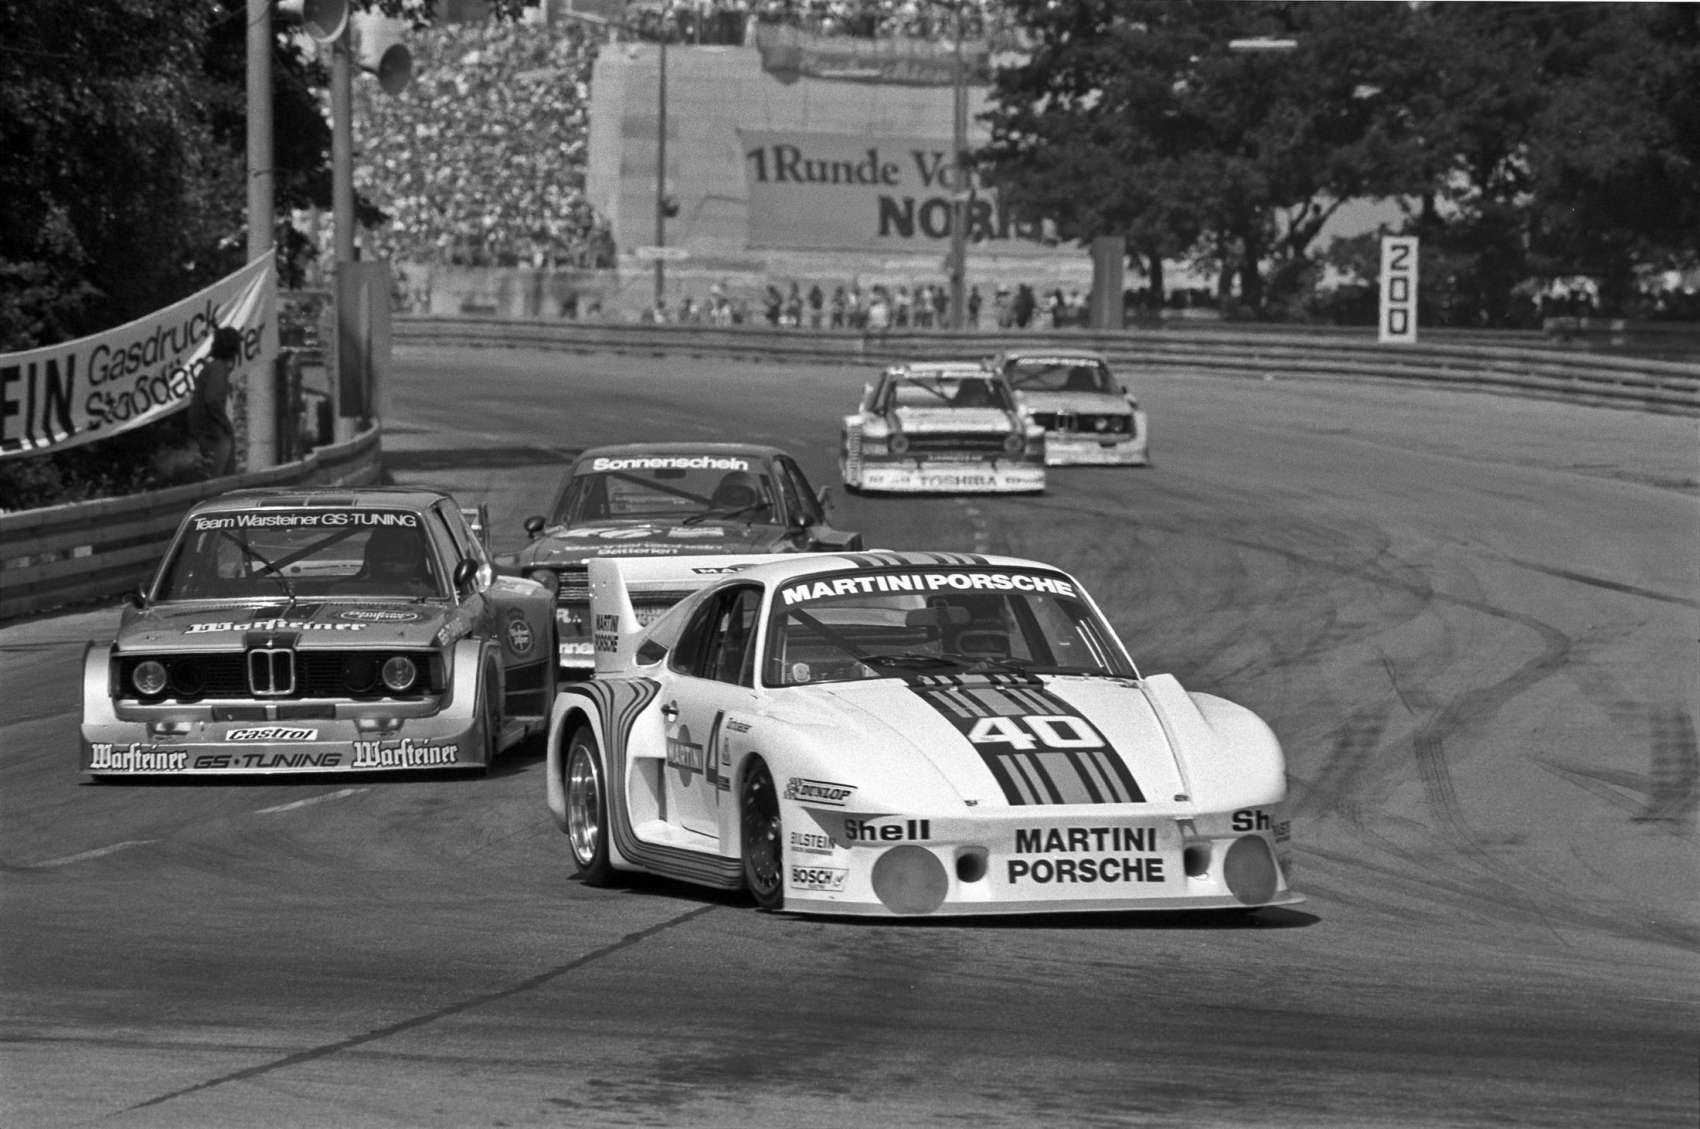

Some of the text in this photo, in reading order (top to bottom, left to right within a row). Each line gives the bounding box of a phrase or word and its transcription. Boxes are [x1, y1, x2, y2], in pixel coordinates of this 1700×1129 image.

[1389, 244, 1410, 335] 200
[87, 299, 220, 388] Gasdruck
[0, 354, 76, 447] EIN
[592, 456, 749, 472] Sonnenschein
[193, 517, 235, 531] Team
[237, 514, 321, 528] Warsteiner
[229, 727, 314, 741] Castrol
[967, 714, 1106, 751] 40
[800, 784, 852, 801] DUNLOP
[844, 819, 931, 841] Shell
[1015, 827, 1156, 853] MARTINI
[792, 868, 834, 884] BOSCH
[1008, 857, 1165, 884] PORSCHE
